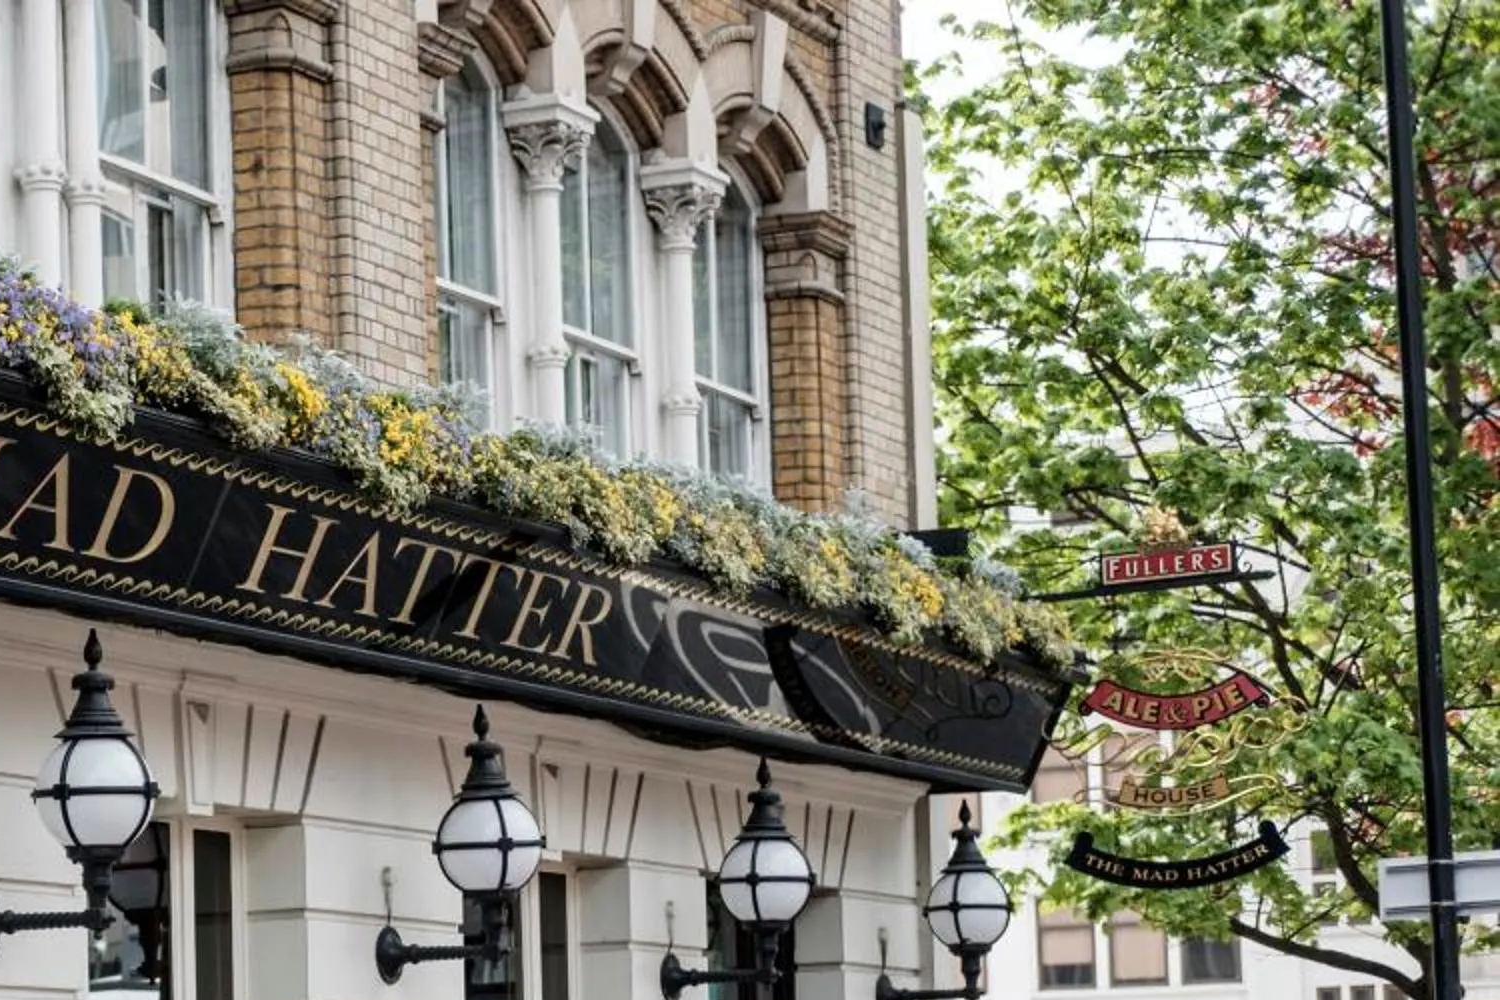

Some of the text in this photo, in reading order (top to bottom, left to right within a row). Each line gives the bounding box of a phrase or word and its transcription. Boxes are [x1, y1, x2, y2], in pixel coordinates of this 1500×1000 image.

[234, 502, 613, 667] HATTER
[1101, 683, 1247, 724] ALE & PIE
[1133, 782, 1217, 805] HOUSE
[1085, 842, 1270, 882] THE MAD HATTER
